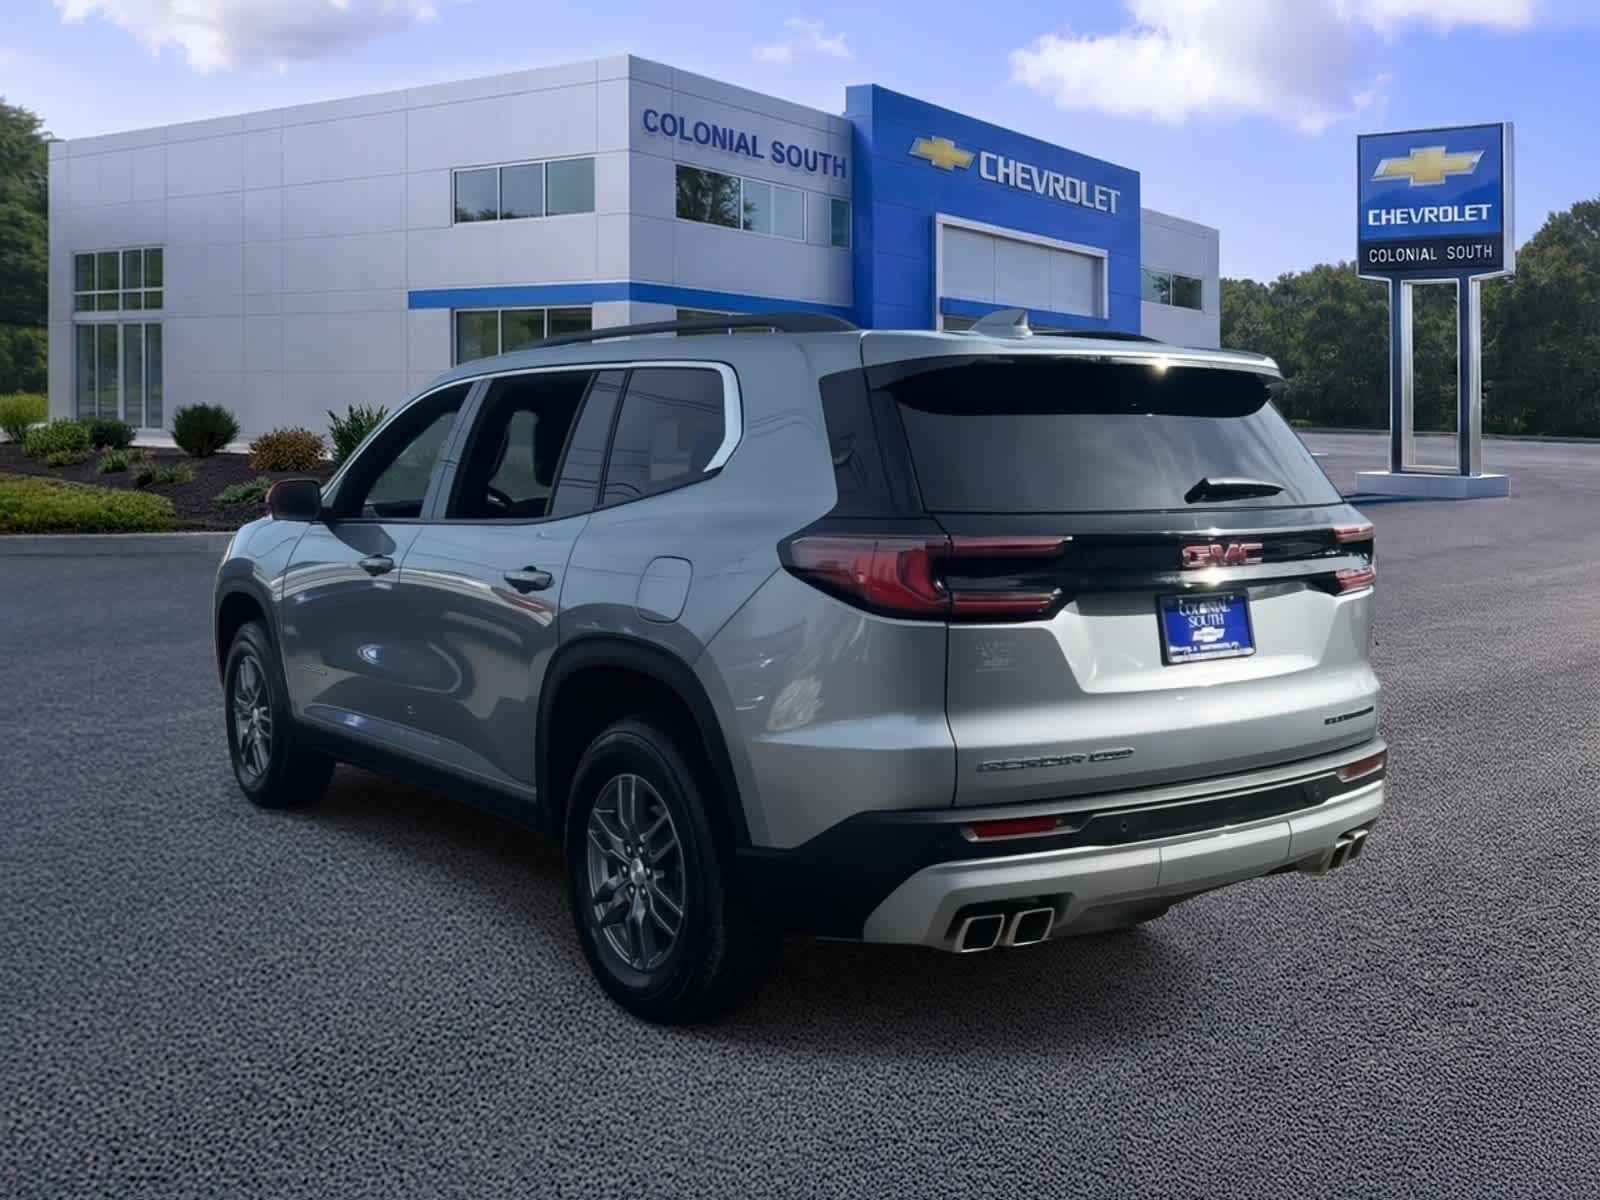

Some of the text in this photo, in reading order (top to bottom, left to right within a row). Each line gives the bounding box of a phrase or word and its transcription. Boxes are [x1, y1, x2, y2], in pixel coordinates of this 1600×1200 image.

[643, 109, 847, 179] COLONIAL SOUTH
[980, 151, 1120, 214] CHEVROLET
[1368, 204, 1492, 226] CHEVROLET
[1369, 244, 1492, 263] COLONIAL SOUTH
[1182, 543, 1263, 568] GMC
[1188, 614, 1224, 628] SOUTH
